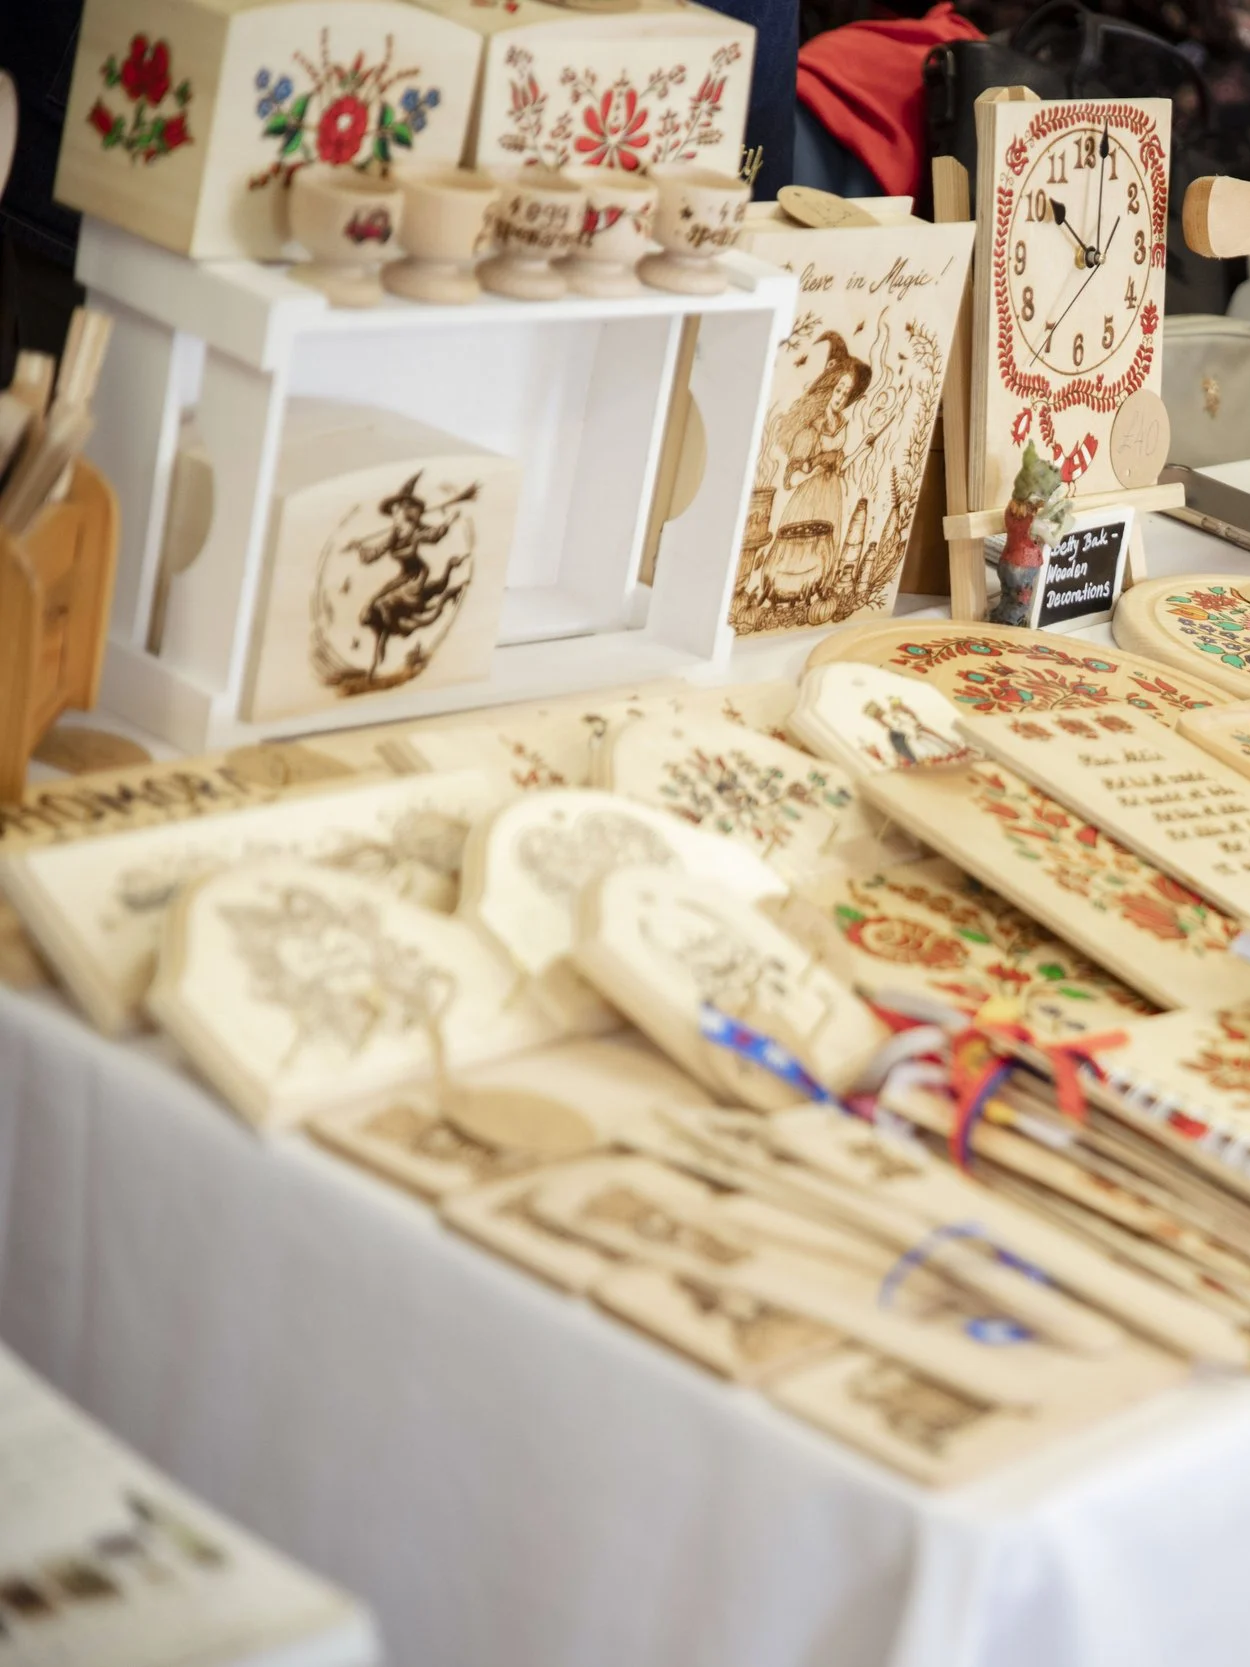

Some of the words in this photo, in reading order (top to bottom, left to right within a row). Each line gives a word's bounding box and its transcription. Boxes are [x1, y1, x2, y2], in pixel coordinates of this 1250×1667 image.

[1046, 151, 1069, 184] 11
[1073, 136, 1096, 169] 12
[1108, 148, 1118, 181] 1
[1025, 188, 1047, 222] 10
[1127, 182, 1140, 215] 2
[1014, 240, 1027, 275] 9
[1134, 230, 1146, 265] 3
[845, 271, 866, 290] in
[1124, 275, 1137, 310] 4
[1021, 286, 1035, 321] 8
[1044, 320, 1056, 353] 7
[1102, 315, 1114, 350] 5
[1072, 333, 1084, 366] 6
[1082, 527, 1108, 552] Bak
[1046, 559, 1088, 585] Wooden
[1046, 581, 1110, 608] Decorations
